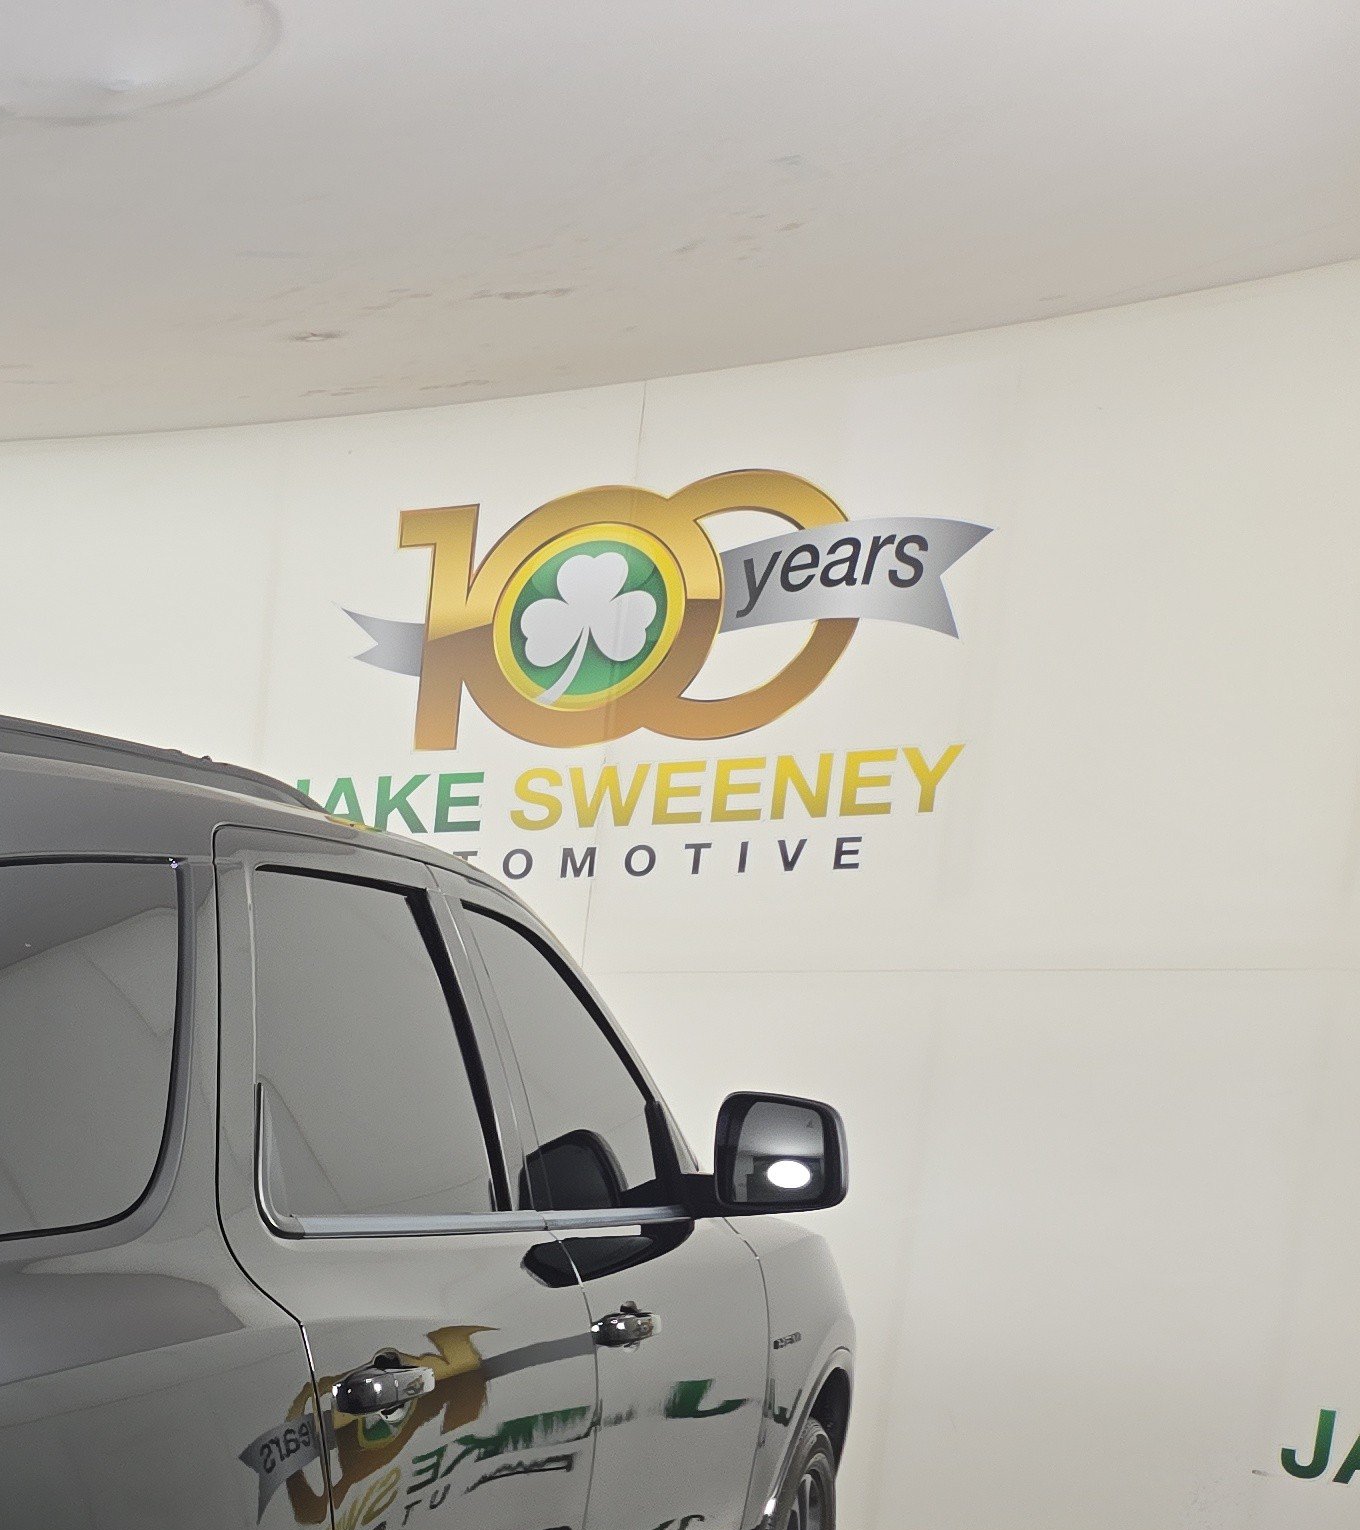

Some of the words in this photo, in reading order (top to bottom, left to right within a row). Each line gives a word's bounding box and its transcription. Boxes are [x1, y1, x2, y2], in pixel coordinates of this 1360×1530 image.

[397, 469, 860, 752] 100
[735, 532, 930, 619] years
[509, 743, 967, 832] SWEENEY
